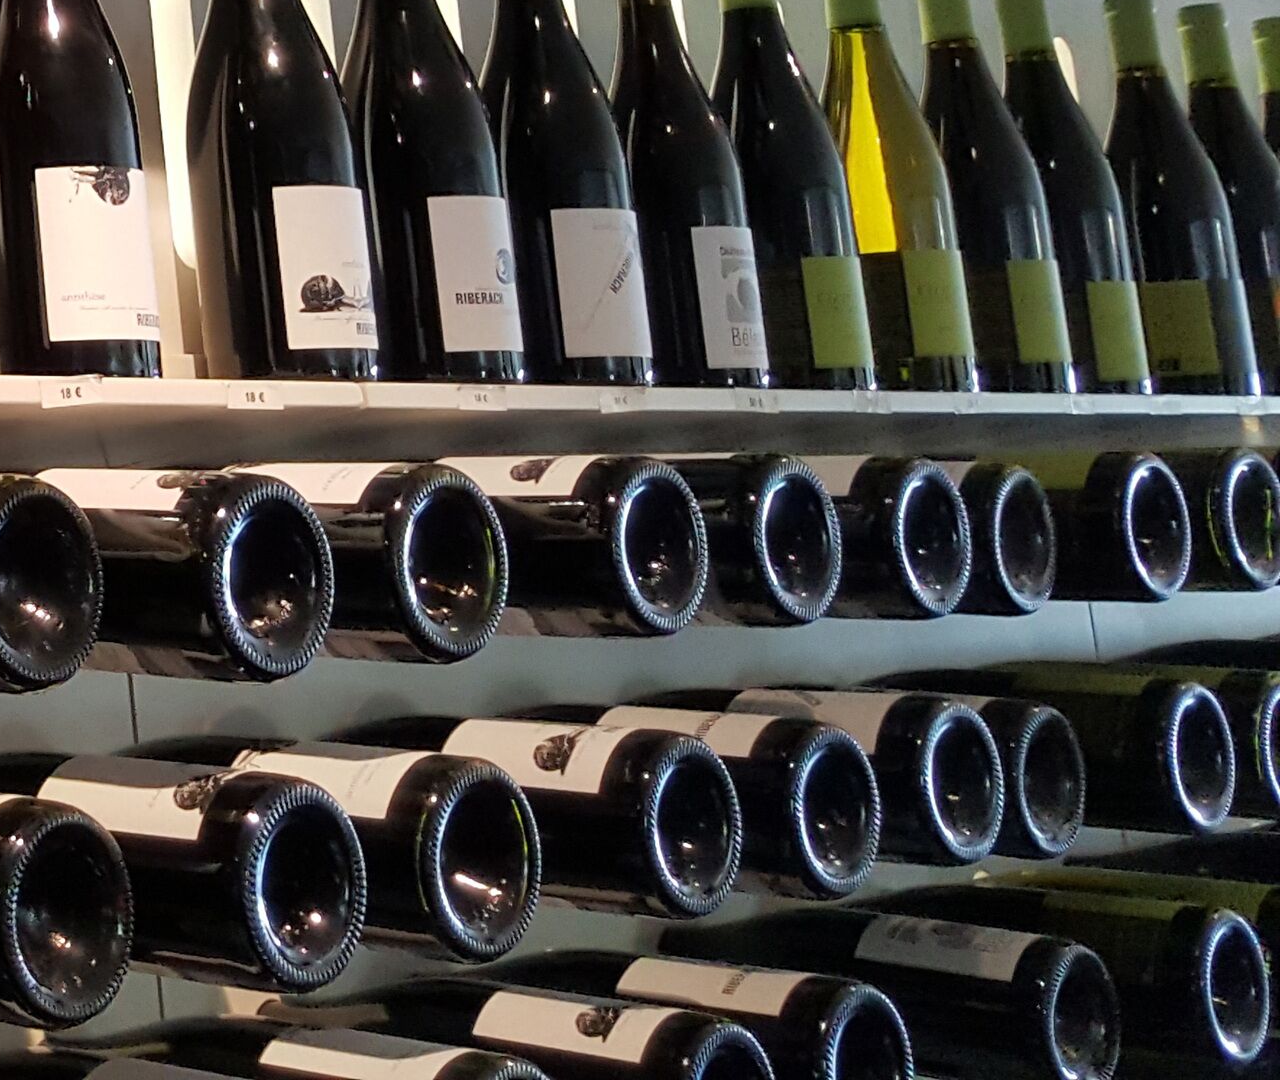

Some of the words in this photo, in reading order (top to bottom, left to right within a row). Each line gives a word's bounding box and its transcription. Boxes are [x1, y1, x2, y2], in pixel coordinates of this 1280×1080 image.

[455, 292, 505, 306] RIBERACH
[61, 388, 71, 399] 18
[75, 386, 82, 397] €
